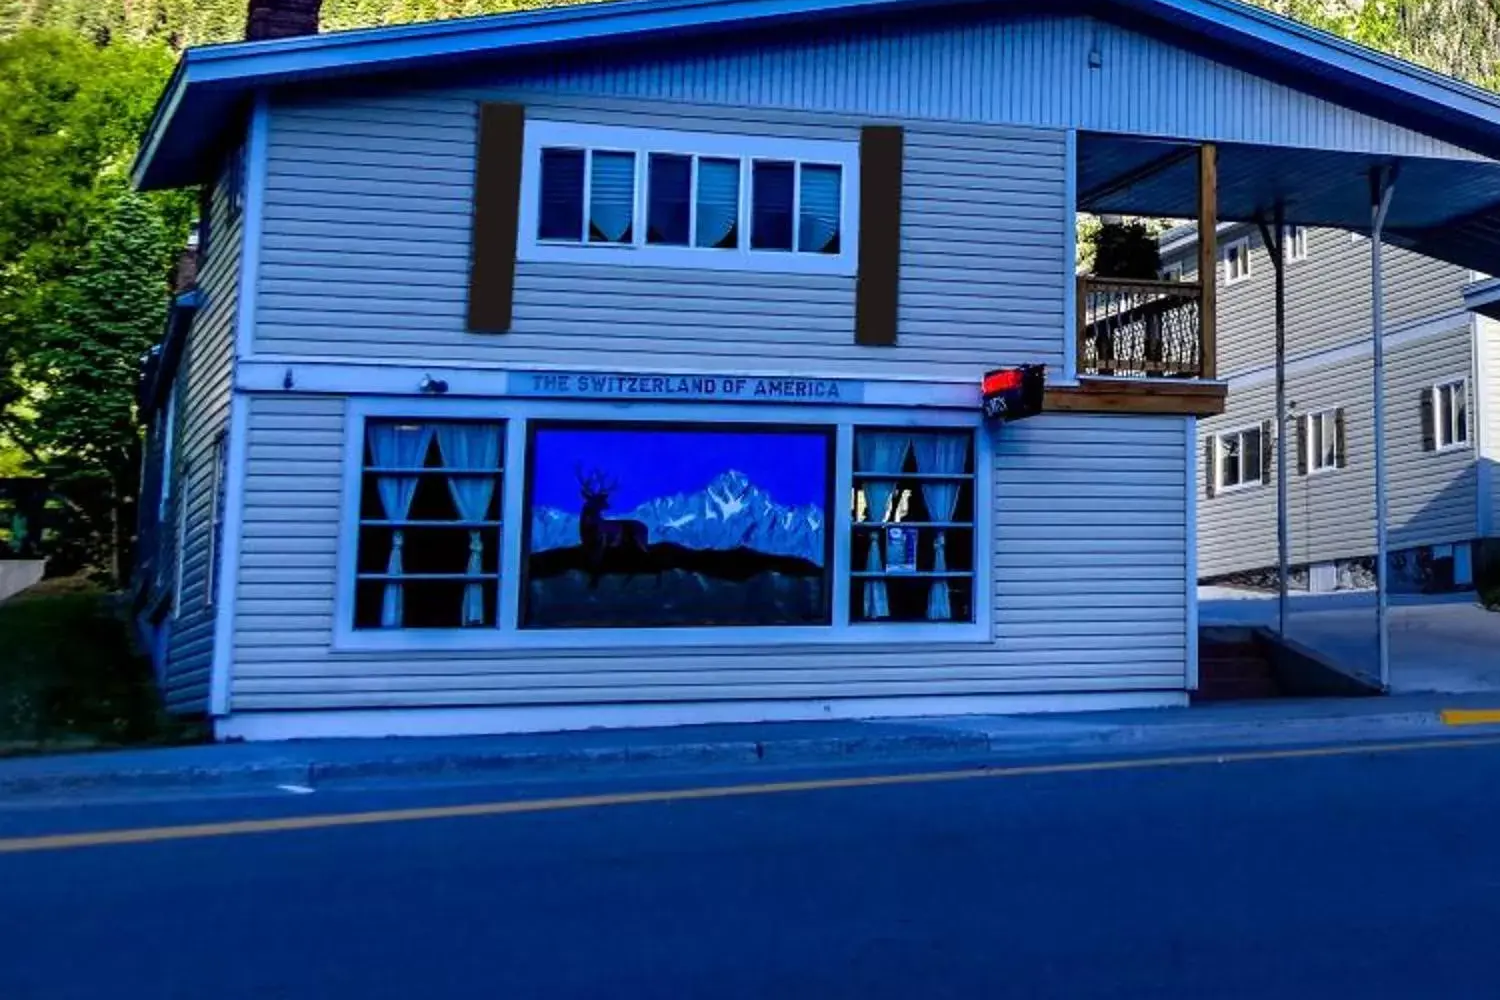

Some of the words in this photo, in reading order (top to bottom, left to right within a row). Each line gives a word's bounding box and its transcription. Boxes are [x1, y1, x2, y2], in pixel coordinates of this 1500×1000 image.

[532, 374, 570, 392] THE
[577, 375, 717, 395] SWITZERLAND
[722, 379, 745, 394] OF
[753, 378, 841, 399] AMERICA
